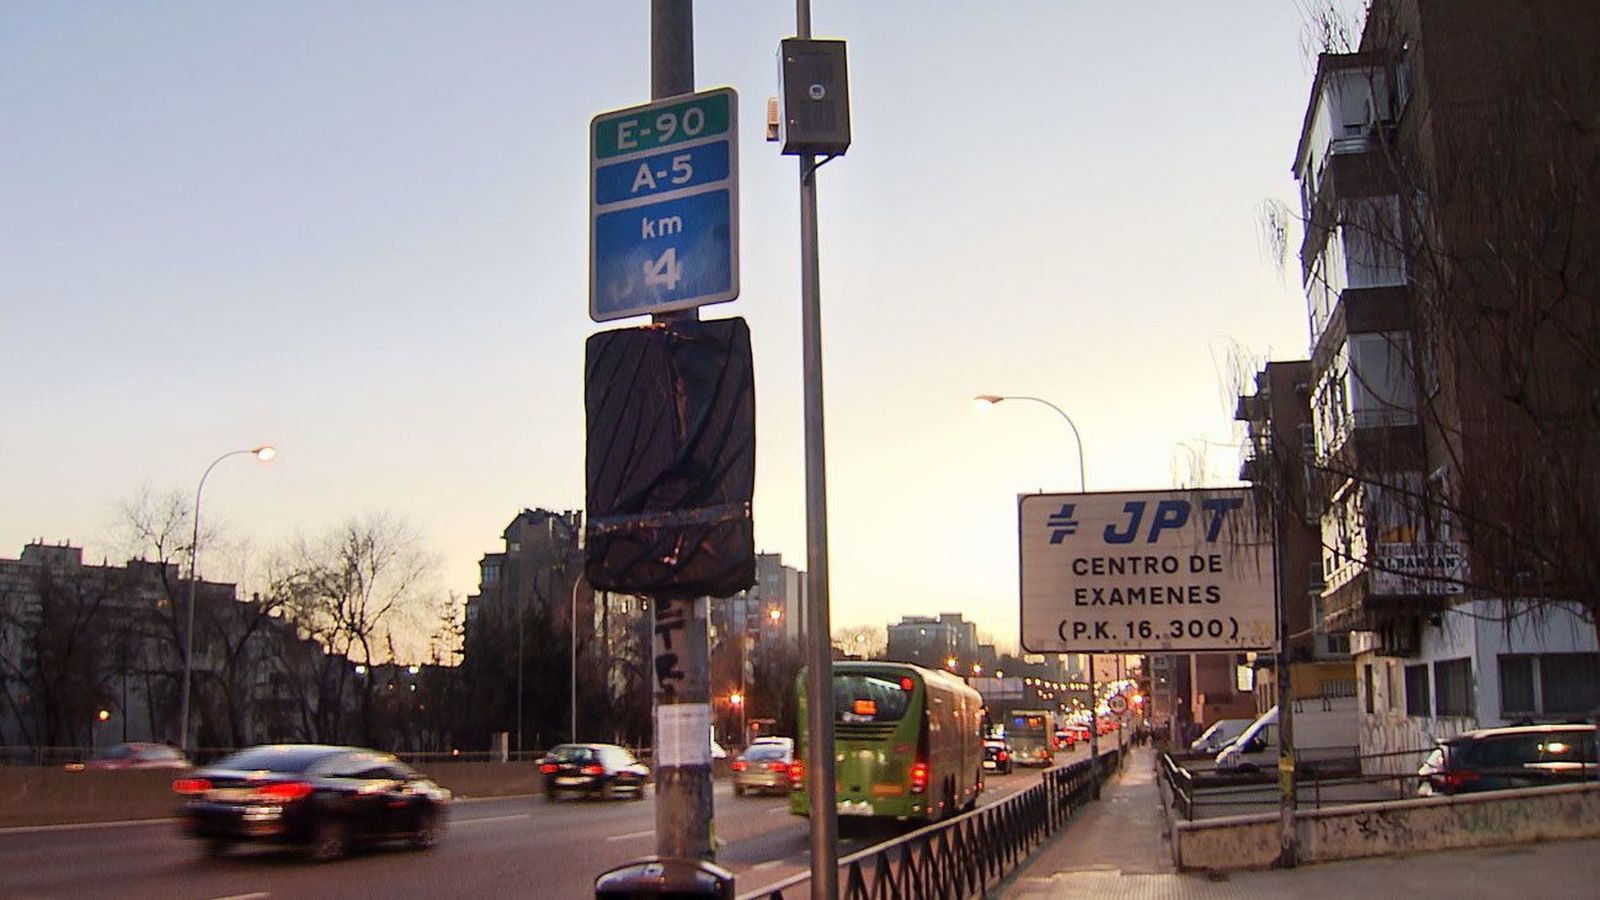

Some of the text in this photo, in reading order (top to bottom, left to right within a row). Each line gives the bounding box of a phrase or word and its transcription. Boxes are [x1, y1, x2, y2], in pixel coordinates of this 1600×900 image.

[617, 107, 705, 149] E-90
[631, 154, 692, 192] A-5
[641, 214, 682, 239] km
[1103, 498, 1243, 544] JPT
[1072, 554, 1222, 576] CENTRO DE
[1074, 585, 1221, 607] EXAMENES
[1058, 619, 1117, 642] (P.K.
